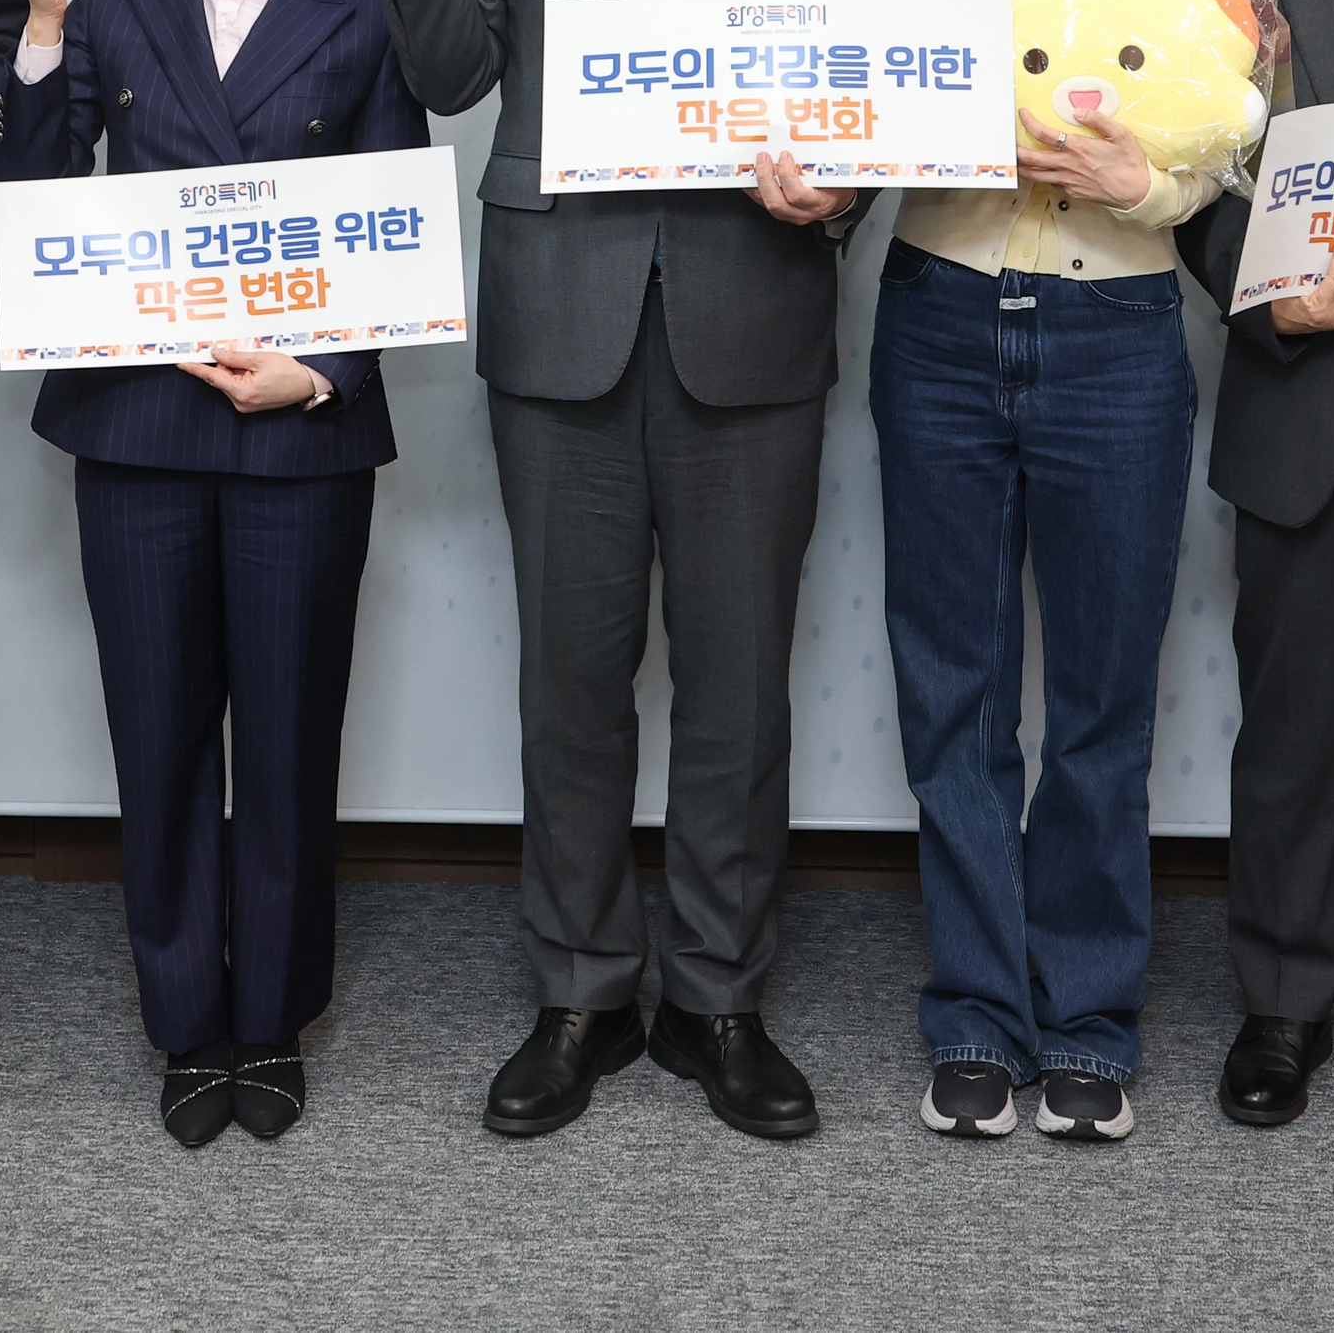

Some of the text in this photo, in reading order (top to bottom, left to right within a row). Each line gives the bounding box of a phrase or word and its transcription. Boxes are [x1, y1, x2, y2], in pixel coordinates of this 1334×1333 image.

[581, 46, 976, 94] 모두의 건강을 위한
[678, 97, 878, 142] 작은 변화
[35, 207, 423, 275] 모두의 건강을 위한
[136, 268, 331, 321] 작은 변화
